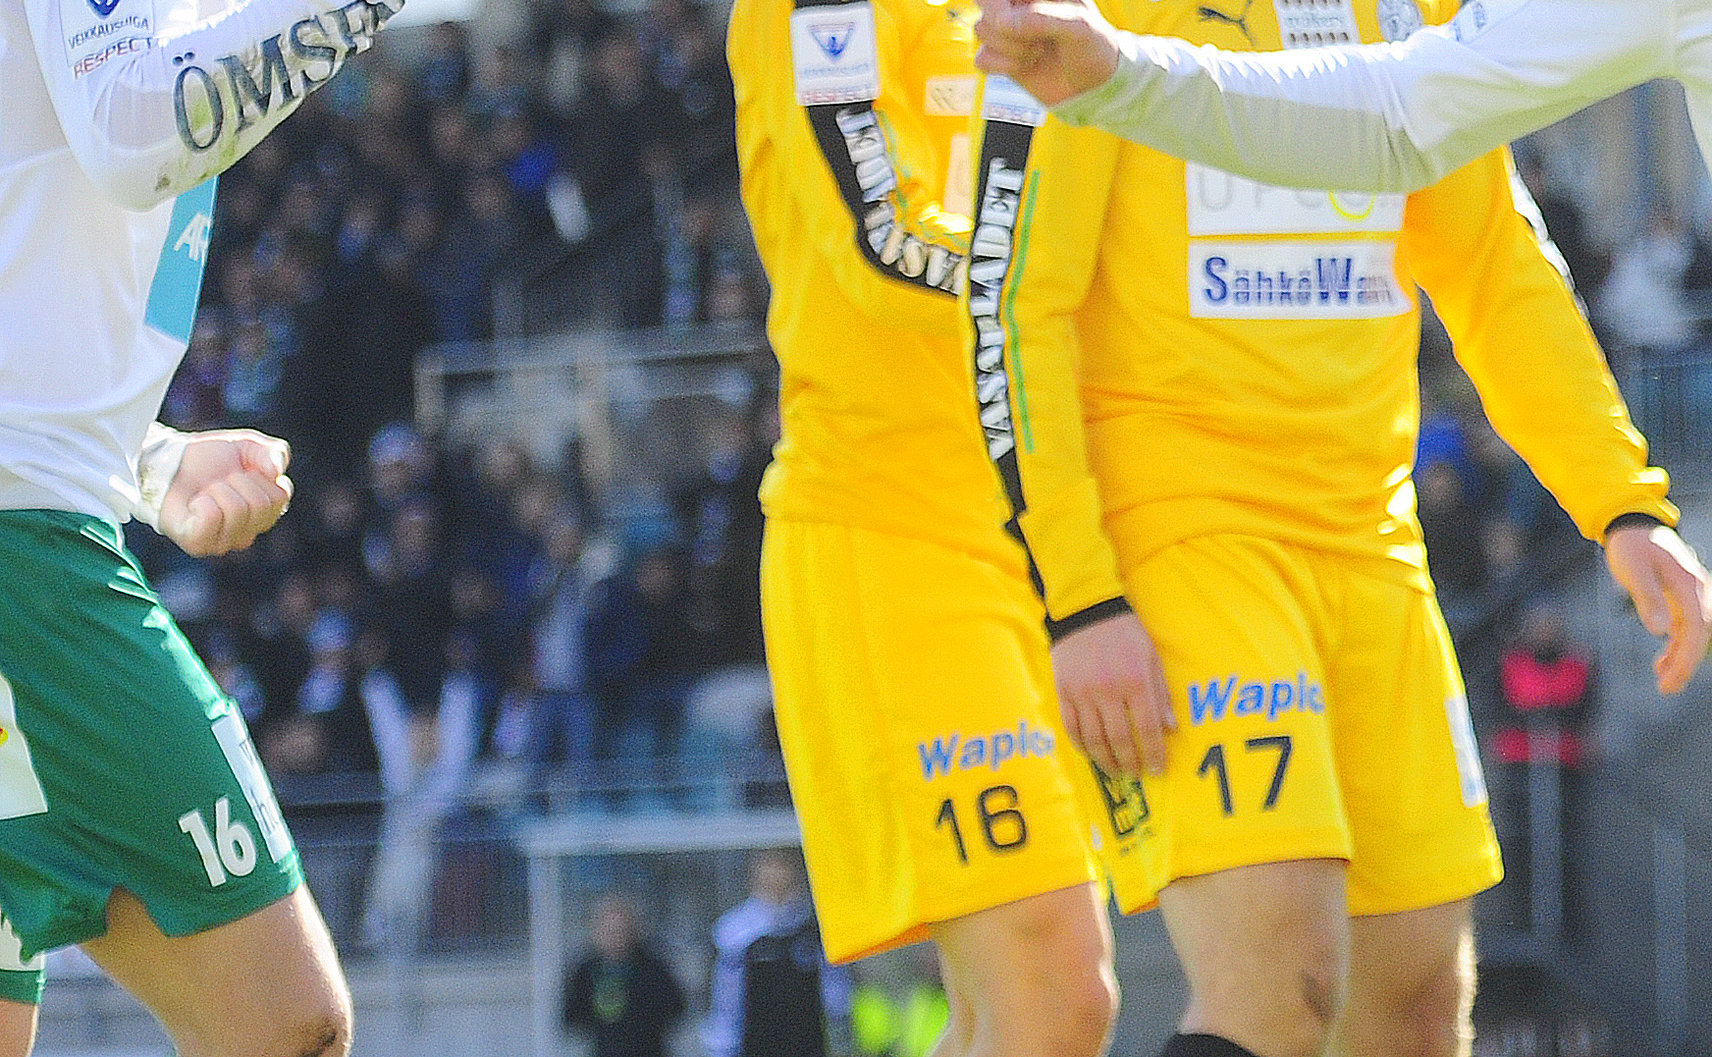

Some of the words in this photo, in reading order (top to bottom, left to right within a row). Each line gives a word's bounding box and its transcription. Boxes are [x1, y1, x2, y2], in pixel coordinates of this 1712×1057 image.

[73, 36, 153, 80] RESPECT
[1197, 735, 1293, 817] 17
[178, 797, 257, 888] 16
[934, 784, 1028, 867] 16
